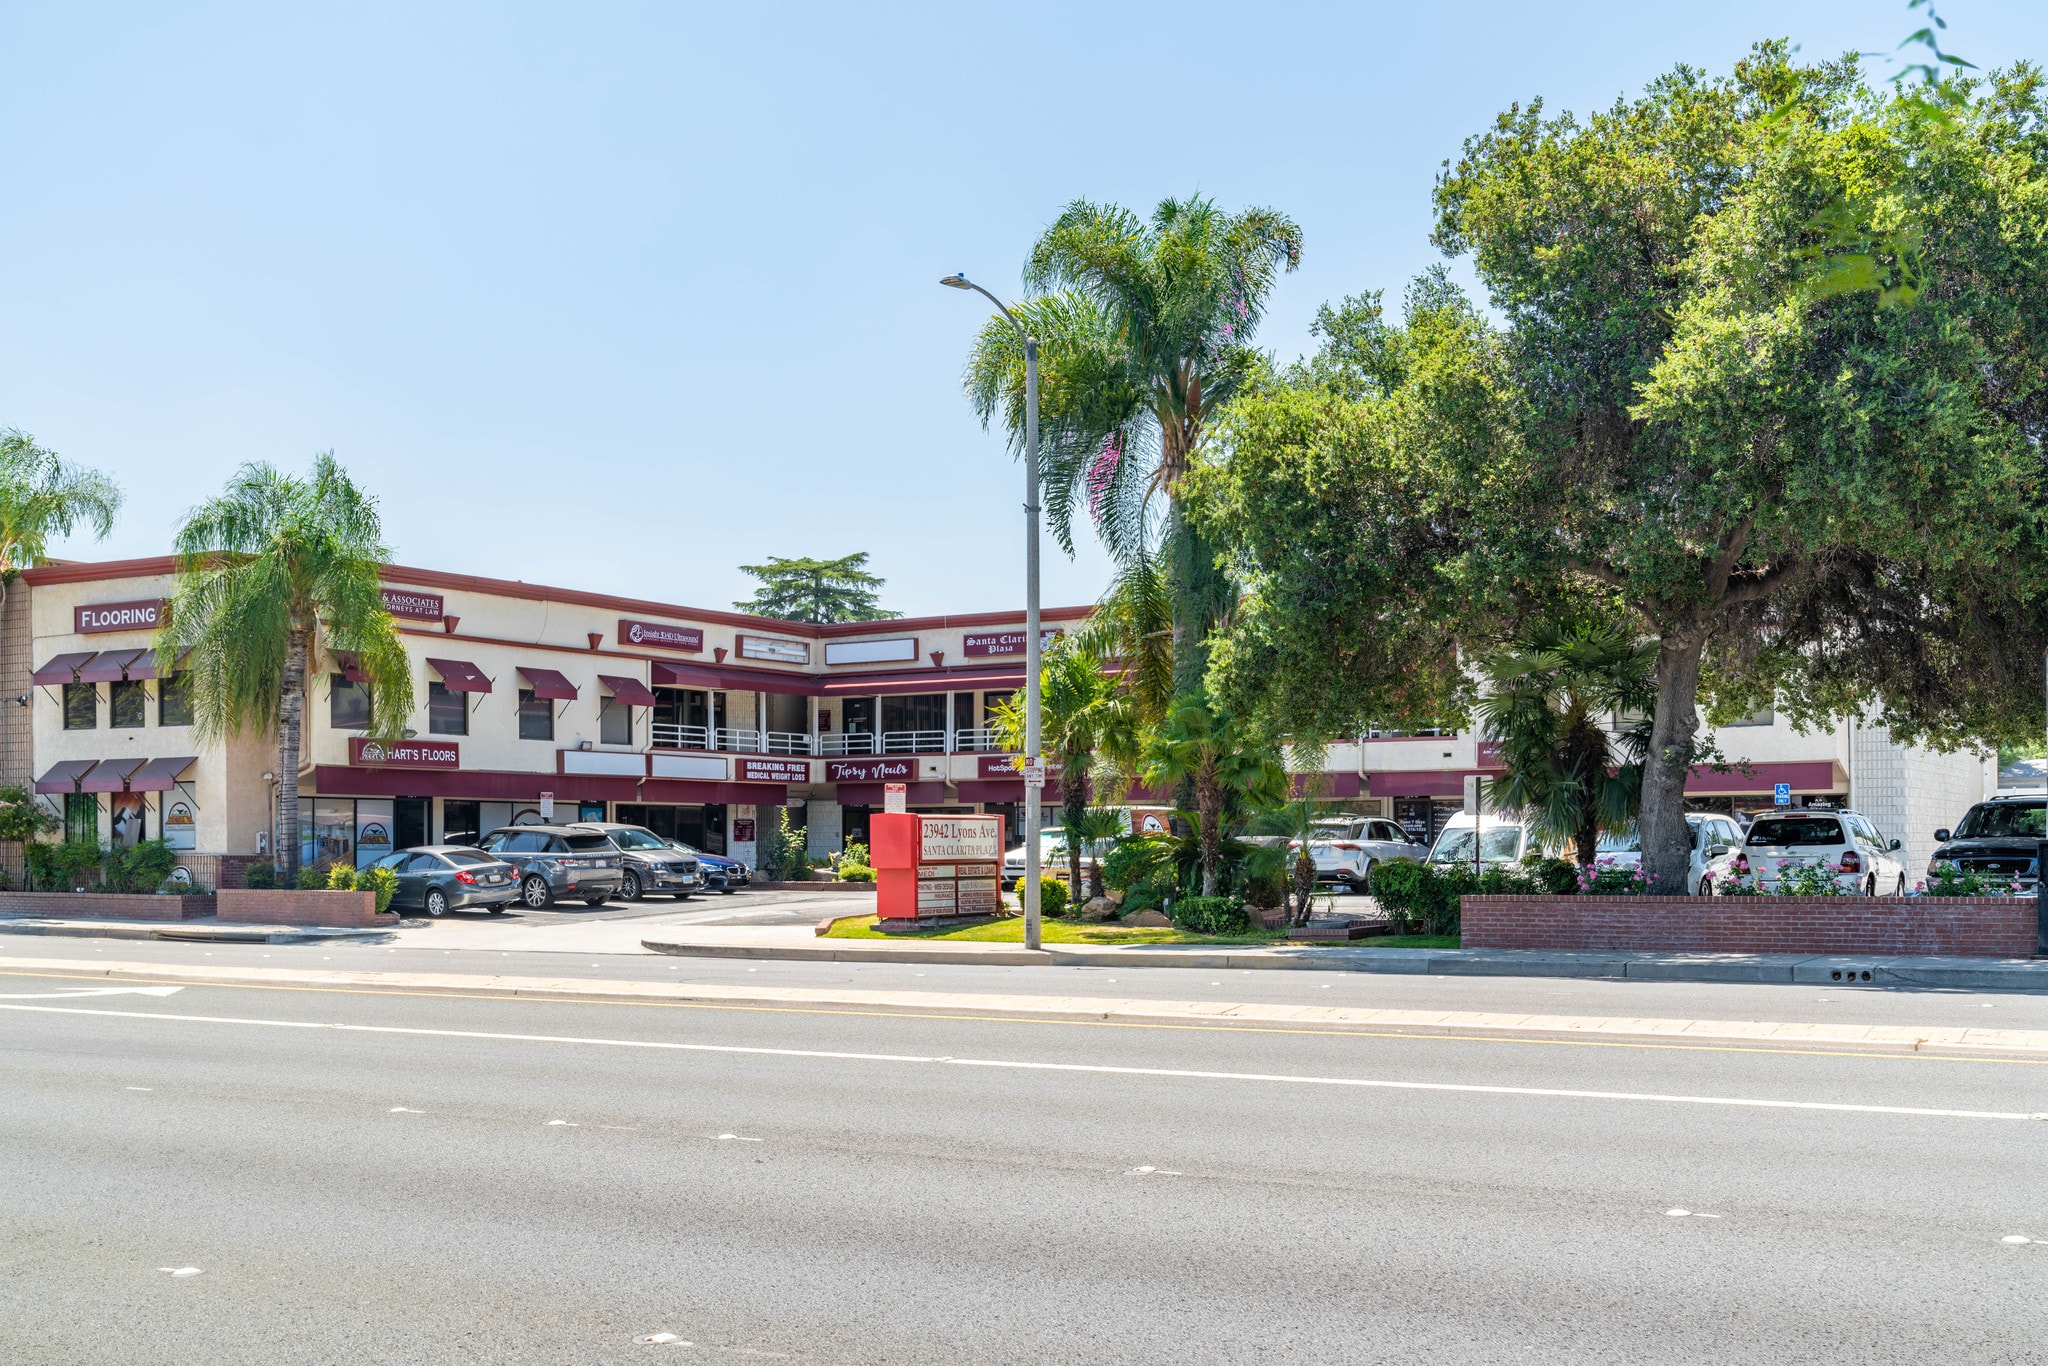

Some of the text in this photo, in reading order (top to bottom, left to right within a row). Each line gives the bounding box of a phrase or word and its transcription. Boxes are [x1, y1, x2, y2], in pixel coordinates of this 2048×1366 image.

[382, 592, 439, 608] & ASSOCIATES
[81, 607, 156, 627] FLOORING
[425, 608, 440, 616] LAW
[966, 634, 1027, 646] Santa Clari
[988, 645, 1013, 654] Plaza
[422, 748, 456, 762] FLOORS
[746, 761, 806, 772] BREAKING FREE
[1026, 758, 1033, 766] NO
[746, 771, 806, 781] MEDICAL WEIGHT LOSS
[831, 763, 908, 780] Tipsy Nails
[923, 823, 998, 842] 23942 Lyons Ave.
[923, 845, 998, 856] SANTA CLARITA PLAZA
